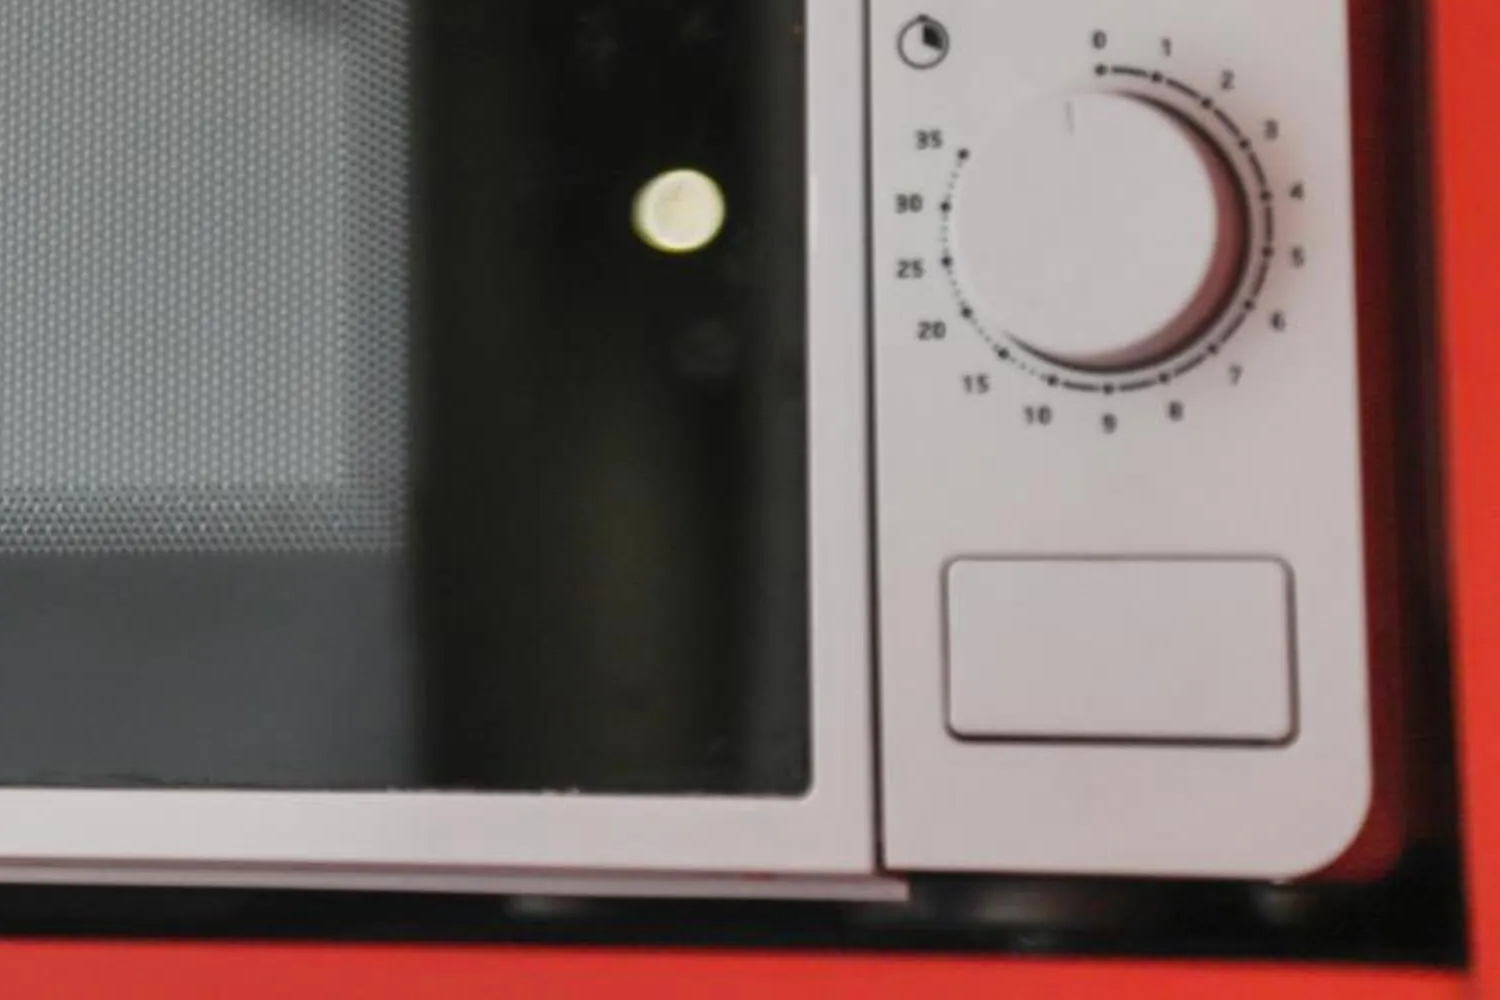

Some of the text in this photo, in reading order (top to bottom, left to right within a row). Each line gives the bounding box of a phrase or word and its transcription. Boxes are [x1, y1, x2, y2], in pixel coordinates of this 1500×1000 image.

[1091, 30, 1107, 50] 0
[1160, 38, 1173, 58] 1
[1219, 70, 1235, 91] 2
[916, 129, 943, 150] 35
[1288, 183, 1304, 202] 4
[895, 193, 923, 214] 30
[1289, 246, 1305, 268] 5
[896, 259, 924, 279] 25
[917, 320, 947, 341] 20
[1269, 311, 1286, 331] 6
[963, 373, 990, 394] 15
[1228, 363, 1243, 385] 7
[1024, 405, 1052, 425] 10
[1168, 401, 1183, 421] 8
[1101, 413, 1117, 433] 9
